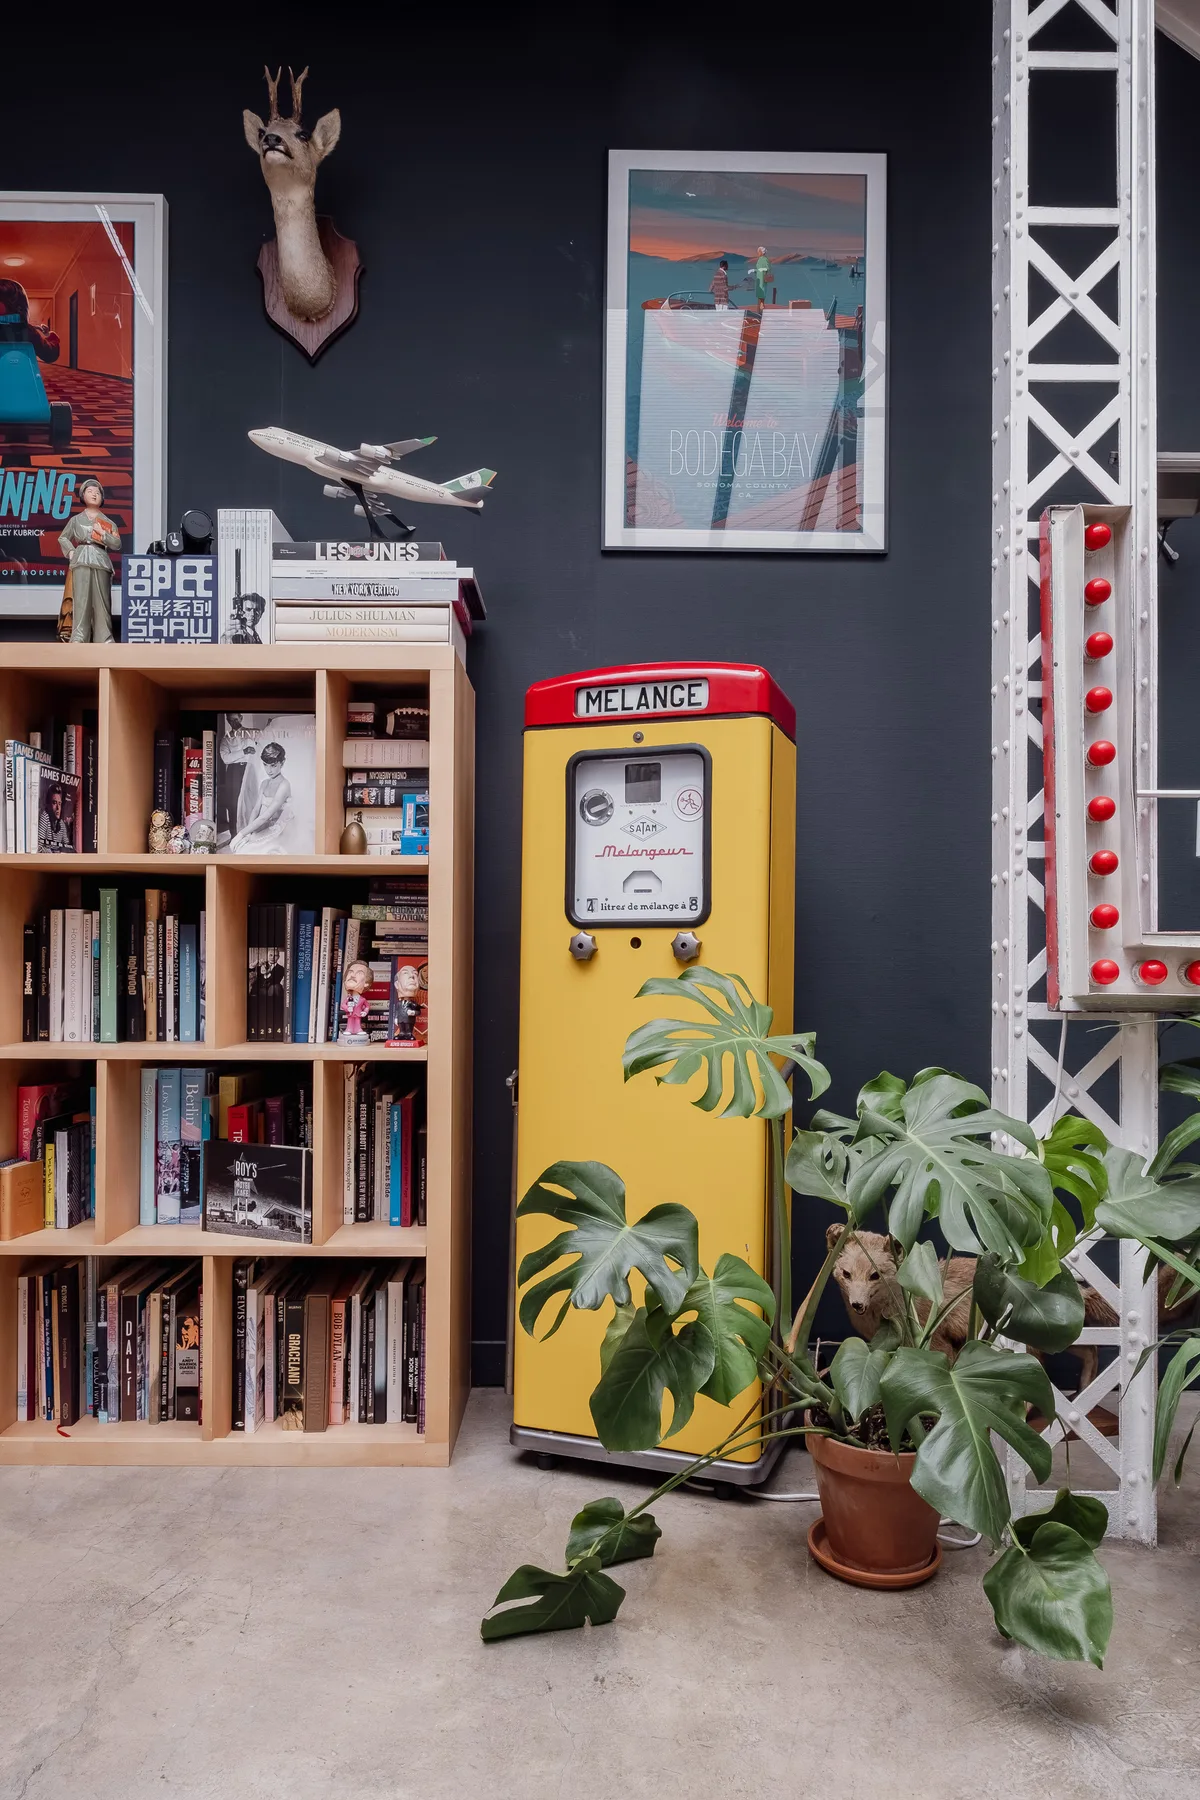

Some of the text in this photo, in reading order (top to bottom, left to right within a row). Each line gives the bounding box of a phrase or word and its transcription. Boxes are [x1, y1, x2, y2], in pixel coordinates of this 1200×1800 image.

[712, 412, 778, 429] Welcome to
[669, 429, 819, 478] BODEGA BAY
[13, 529, 46, 537] KUBRICK
[316, 542, 351, 561] LES
[364, 542, 420, 561] UNES
[332, 582, 400, 597] NEW YORK VERTIGO
[128, 599, 212, 617] 光影系列
[309, 610, 417, 621] JULIUS SHULMAN
[128, 617, 212, 638] SHAW
[326, 628, 399, 638] MODERNISM
[585, 683, 703, 714] MELANGE
[14, 743, 35, 760] JAMES
[5, 759, 14, 802] JAMES DEAN
[40, 767, 80, 788] JAMES DEAN
[189, 779, 200, 801] FILMS
[205, 780, 213, 798] BEALE
[189, 800, 200, 813] DES
[629, 821, 657, 836] SATAM
[600, 902, 626, 912] litres
[627, 902, 639, 911] de
[640, 902, 680, 912] mélange
[688, 898, 698, 911] 8
[70, 928, 79, 969] HOLLYWOOD
[146, 920, 156, 980] HOLLYWOOD
[303, 923, 312, 971] WIM WENDERS
[127, 955, 138, 996] HOLLYWOOD
[297, 951, 305, 980] STORIES
[24, 962, 33, 996] Hollywood
[160, 1084, 173, 1144] Los Angeles
[185, 1083, 199, 1126] Berlin
[359, 1103, 367, 1130] BERENICE
[385, 1117, 391, 1127] on
[359, 1130, 367, 1151] ABBOTT
[235, 1160, 258, 1178] ROY'S
[359, 1153, 367, 1181] CHANGING
[236, 1295, 246, 1337] ELVIS 21
[332, 1312, 343, 1362] BOB DYLAN
[125, 1320, 133, 1396] DALÍ
[288, 1333, 301, 1385] GRACELAND
